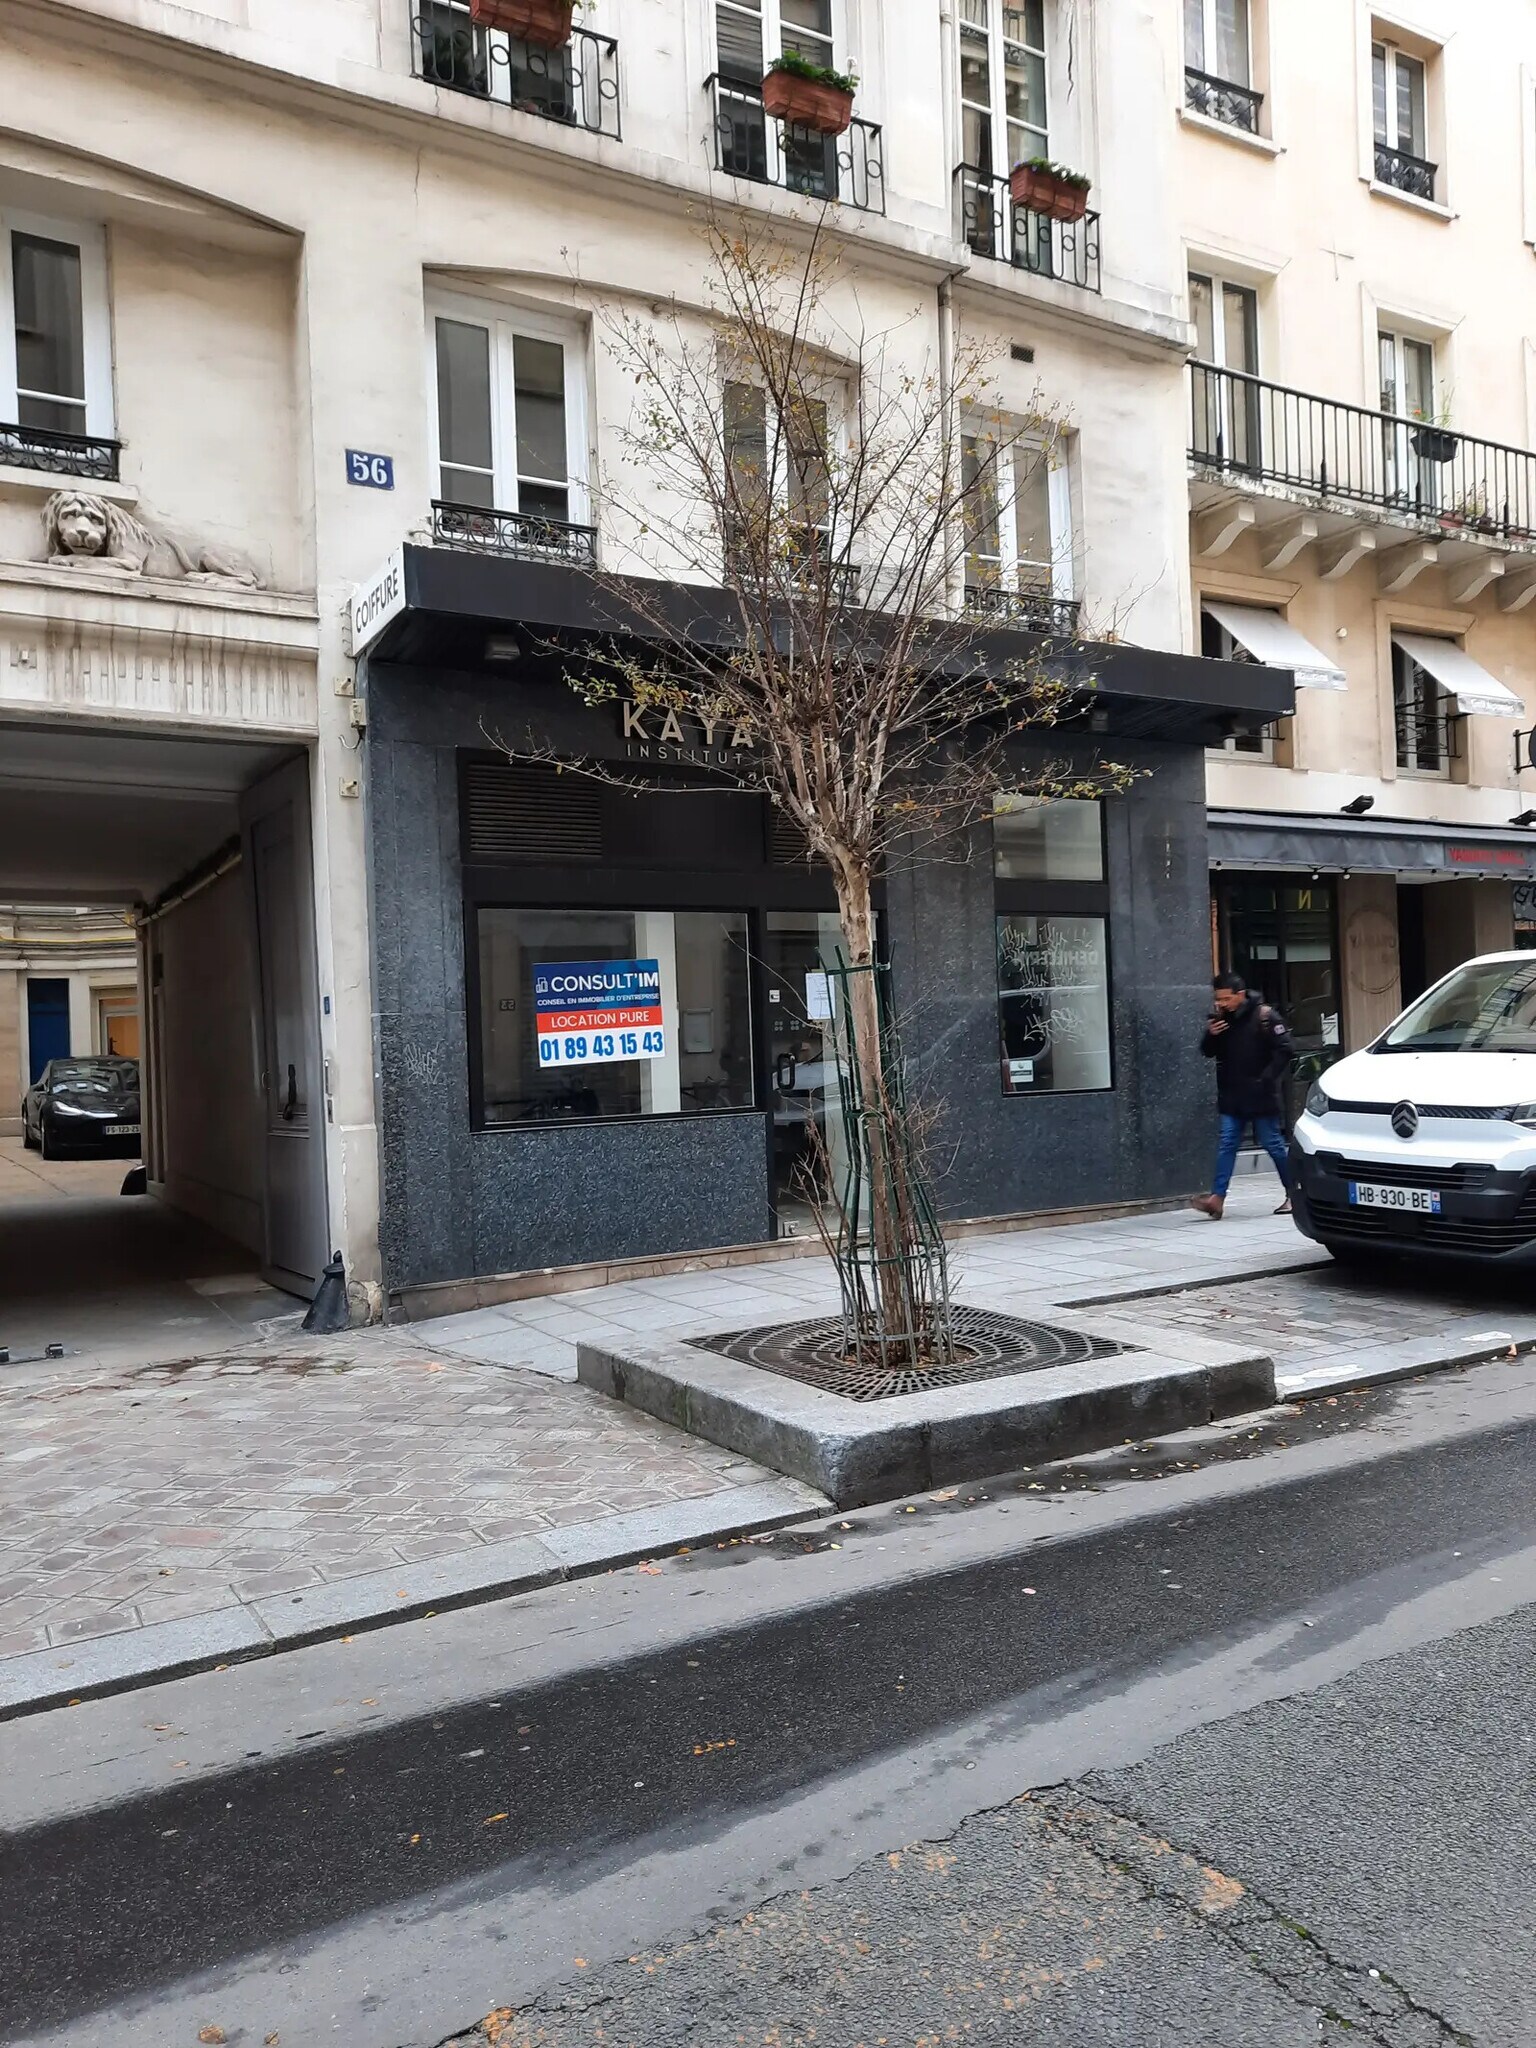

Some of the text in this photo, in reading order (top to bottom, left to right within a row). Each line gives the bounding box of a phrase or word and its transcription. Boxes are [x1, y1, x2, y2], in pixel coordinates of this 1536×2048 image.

[353, 453, 387, 484] 56
[355, 567, 399, 633] COIFFURE
[623, 701, 754, 748] KAYA
[626, 744, 743, 765] INSTITUT
[551, 972, 659, 992] CONSULT'IM
[537, 998, 566, 1006] CONSEIL
[577, 995, 615, 1004] IMMOBILIER
[616, 993, 659, 1002] D'ENTREPRISE
[551, 1010, 649, 1028] LOCATION PURE
[540, 1031, 663, 1061] 01 89 43 15 43
[1358, 1186, 1429, 1209] HB-930-BE
